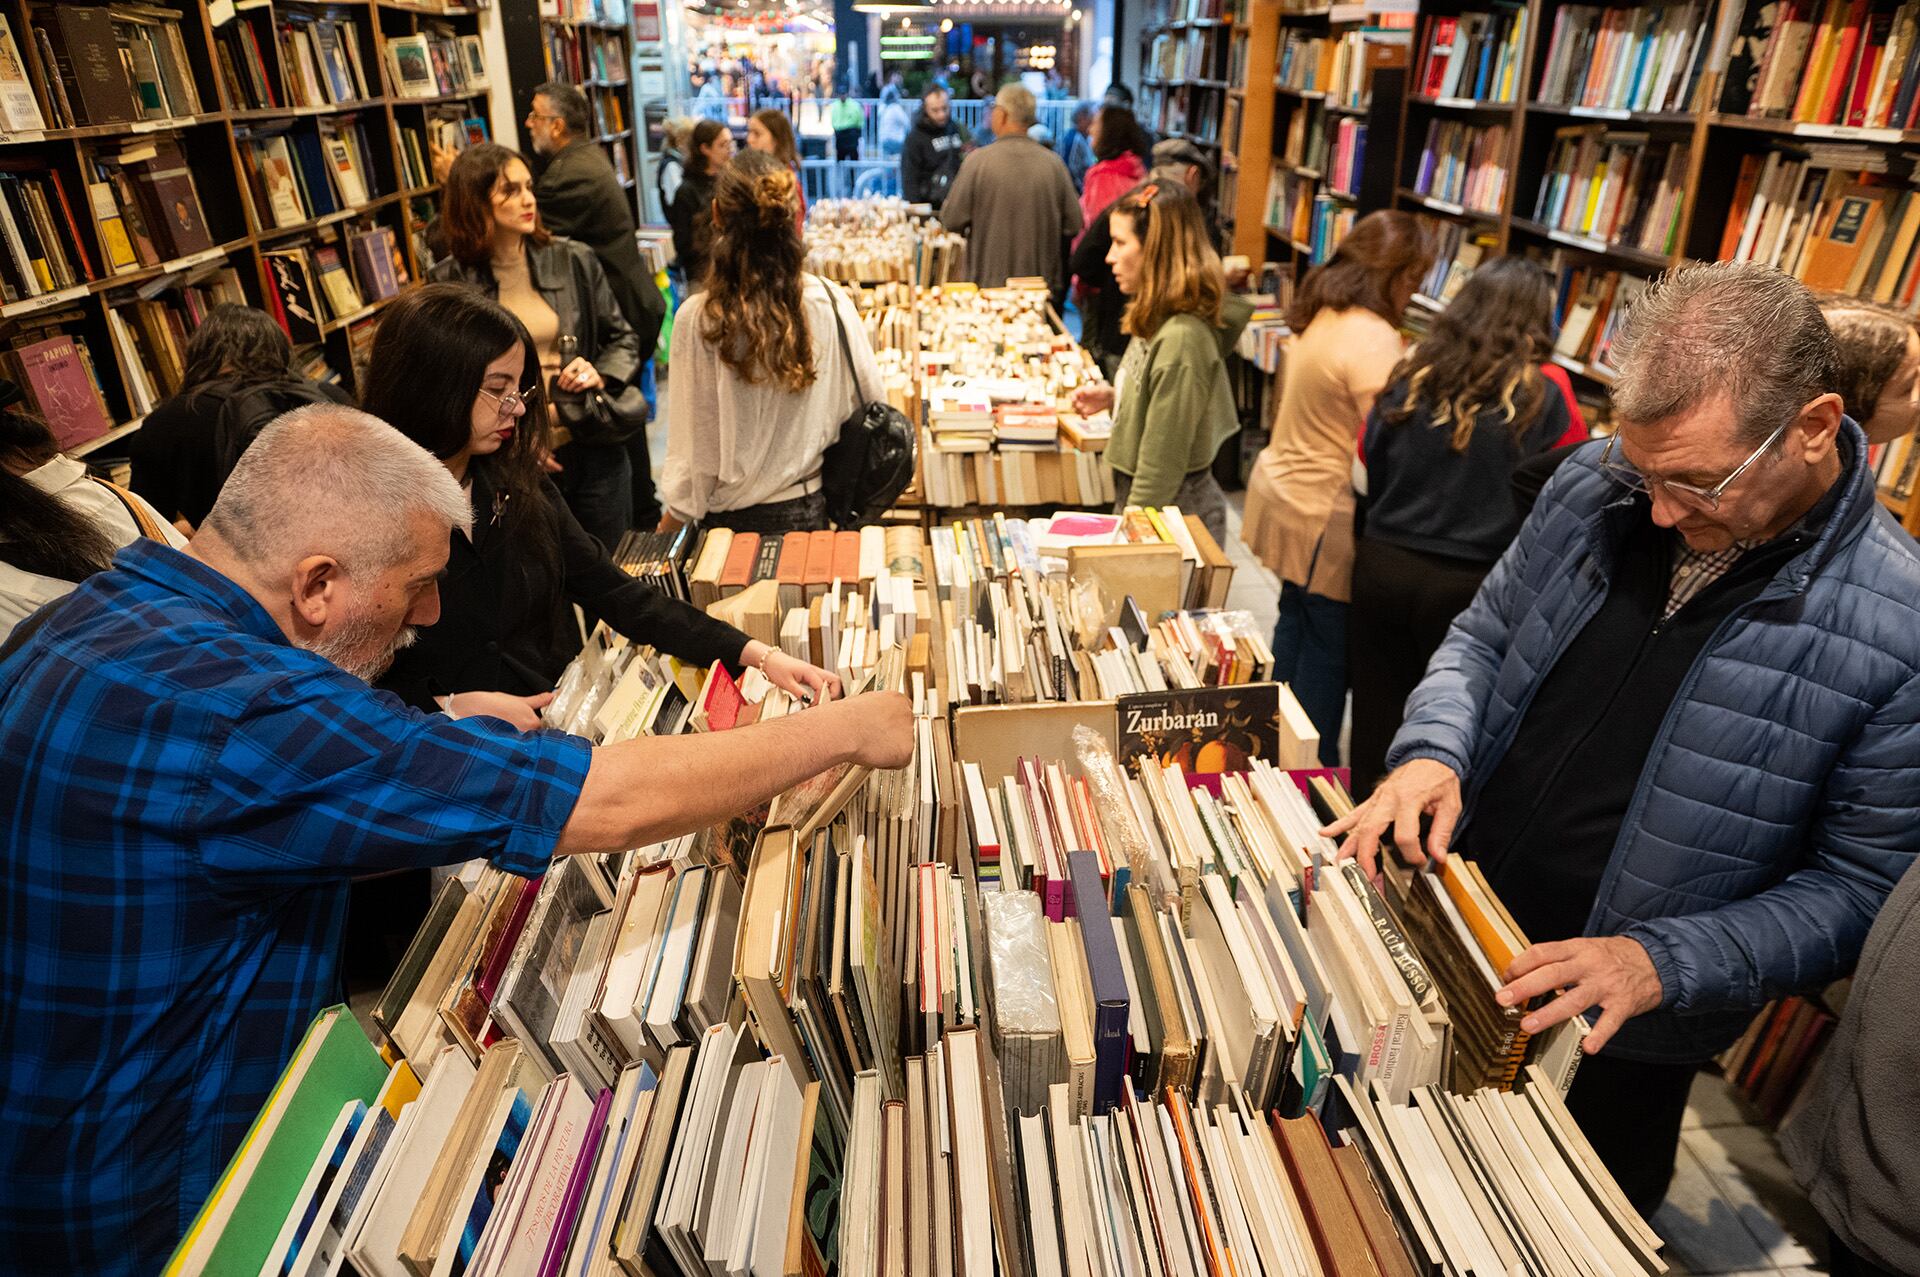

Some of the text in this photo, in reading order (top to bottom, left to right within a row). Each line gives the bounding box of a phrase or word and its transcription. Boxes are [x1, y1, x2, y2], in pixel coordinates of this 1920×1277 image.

[43, 344, 72, 361] PAPINI
[1126, 708, 1219, 733] Zurbarán
[1374, 917, 1428, 994] RAÚL RUSSO
[1369, 1025, 1388, 1067] BROSSA
[1391, 1013, 1409, 1046] Radical
[1500, 1031, 1515, 1056] PERÚ
[1383, 1046, 1401, 1080] Fashion
[525, 1119, 574, 1251] TESOROS DE LA PINTURA
